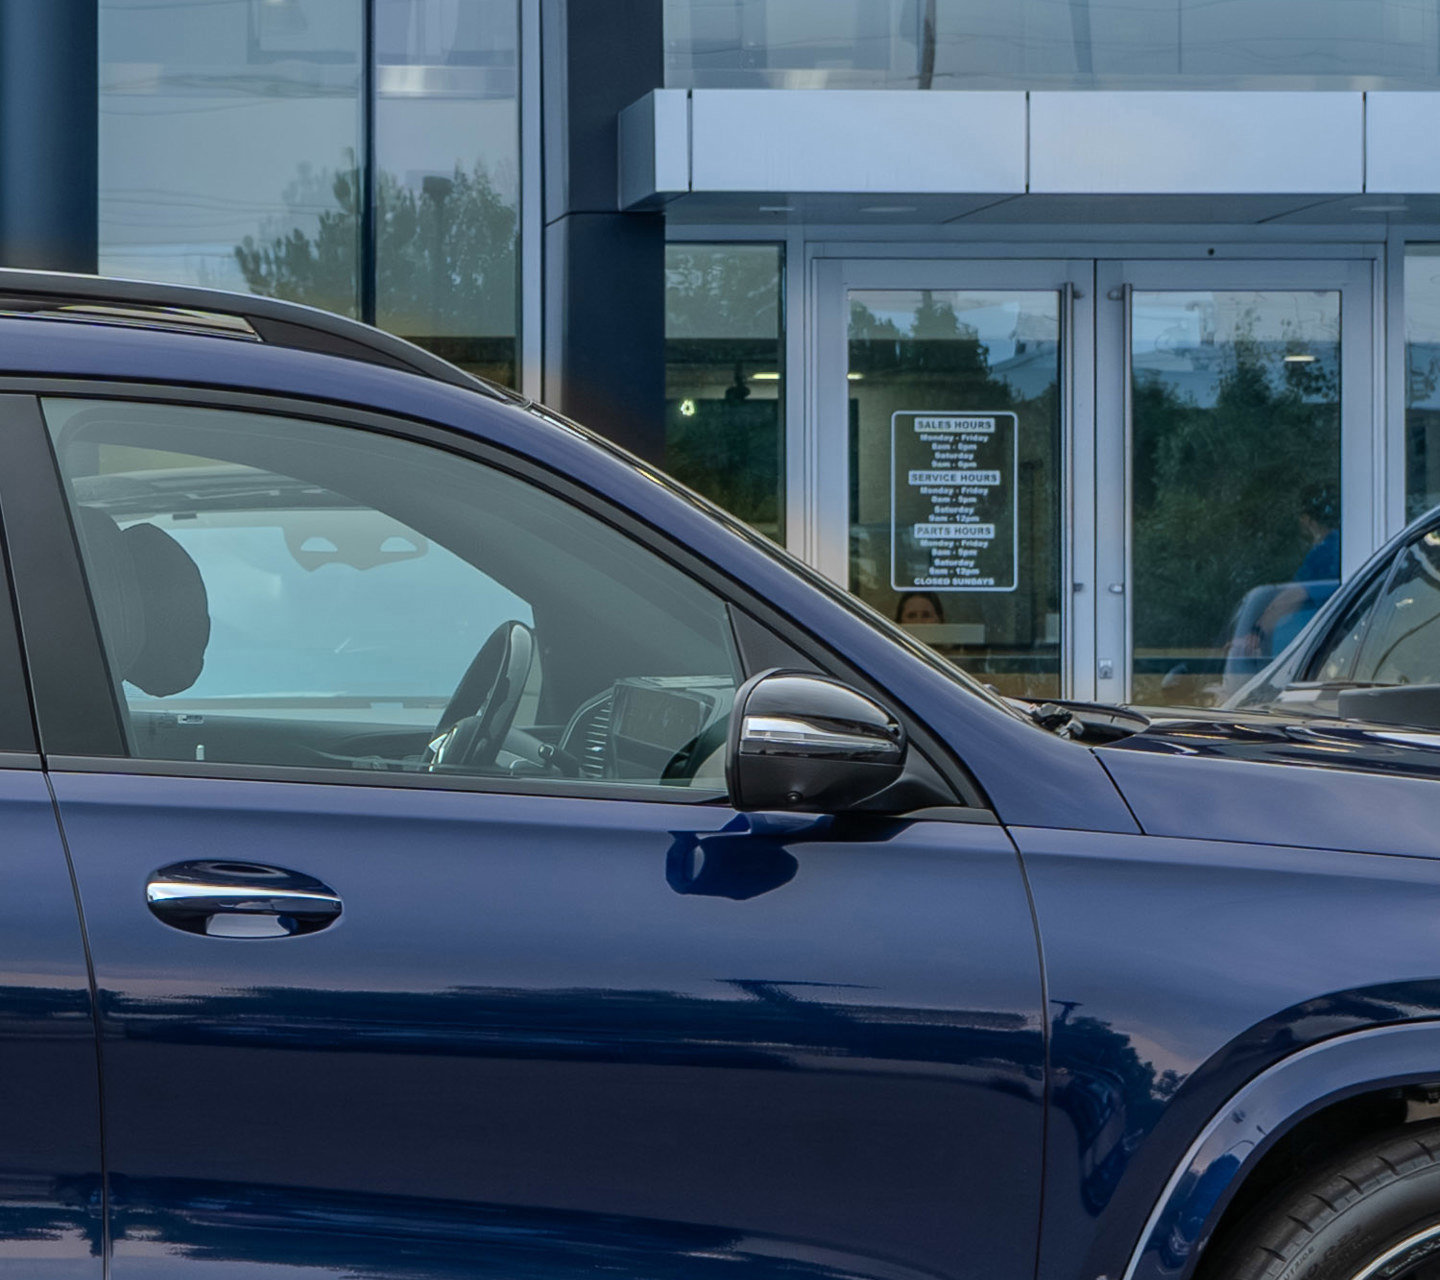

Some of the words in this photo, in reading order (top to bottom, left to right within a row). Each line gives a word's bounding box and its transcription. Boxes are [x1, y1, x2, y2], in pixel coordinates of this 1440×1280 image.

[918, 421, 951, 429] SALES
[954, 421, 992, 429] HOURS
[912, 474, 957, 482] SERVICE
[960, 474, 997, 482] HOURS
[917, 527, 951, 535] PARTS
[954, 527, 991, 535] HOURS
